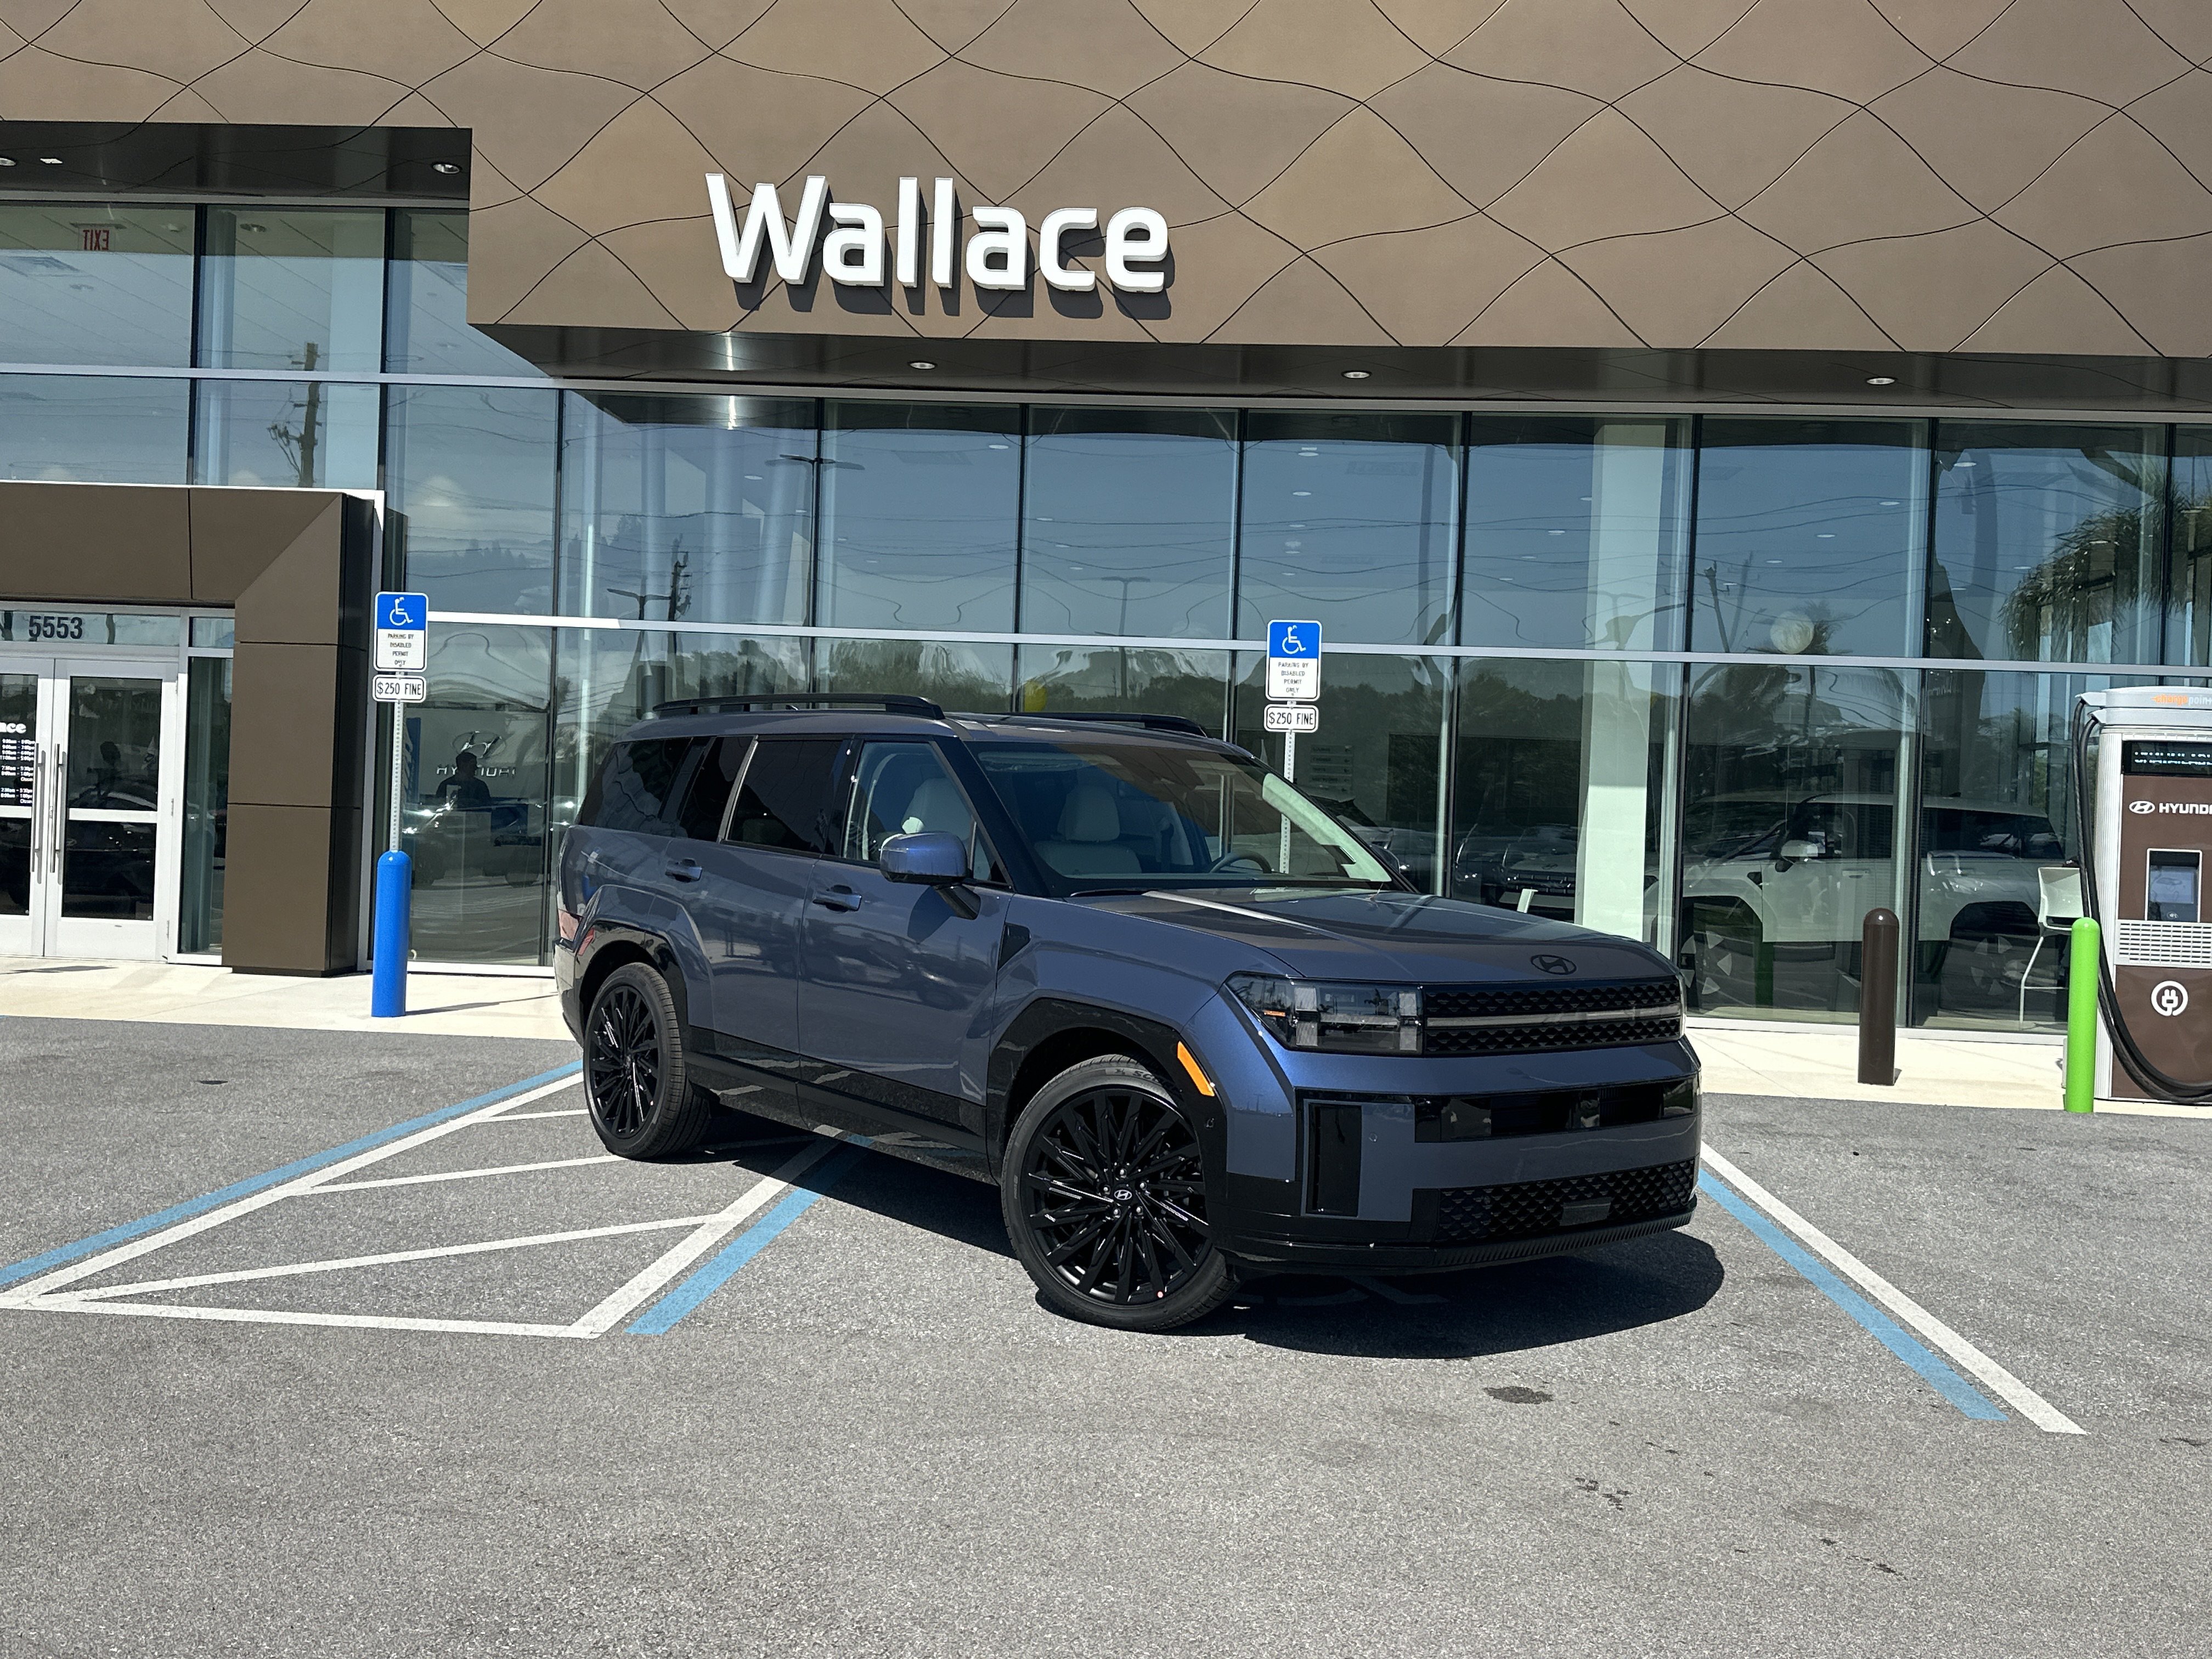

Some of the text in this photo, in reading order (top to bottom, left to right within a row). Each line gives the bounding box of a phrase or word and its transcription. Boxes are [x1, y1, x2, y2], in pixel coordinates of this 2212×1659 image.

[705, 173, 1169, 293] Wallace
[29, 616, 82, 639] 5553
[376, 681, 422, 696] $250 FINE
[1268, 712, 1314, 725] $250 FINE
